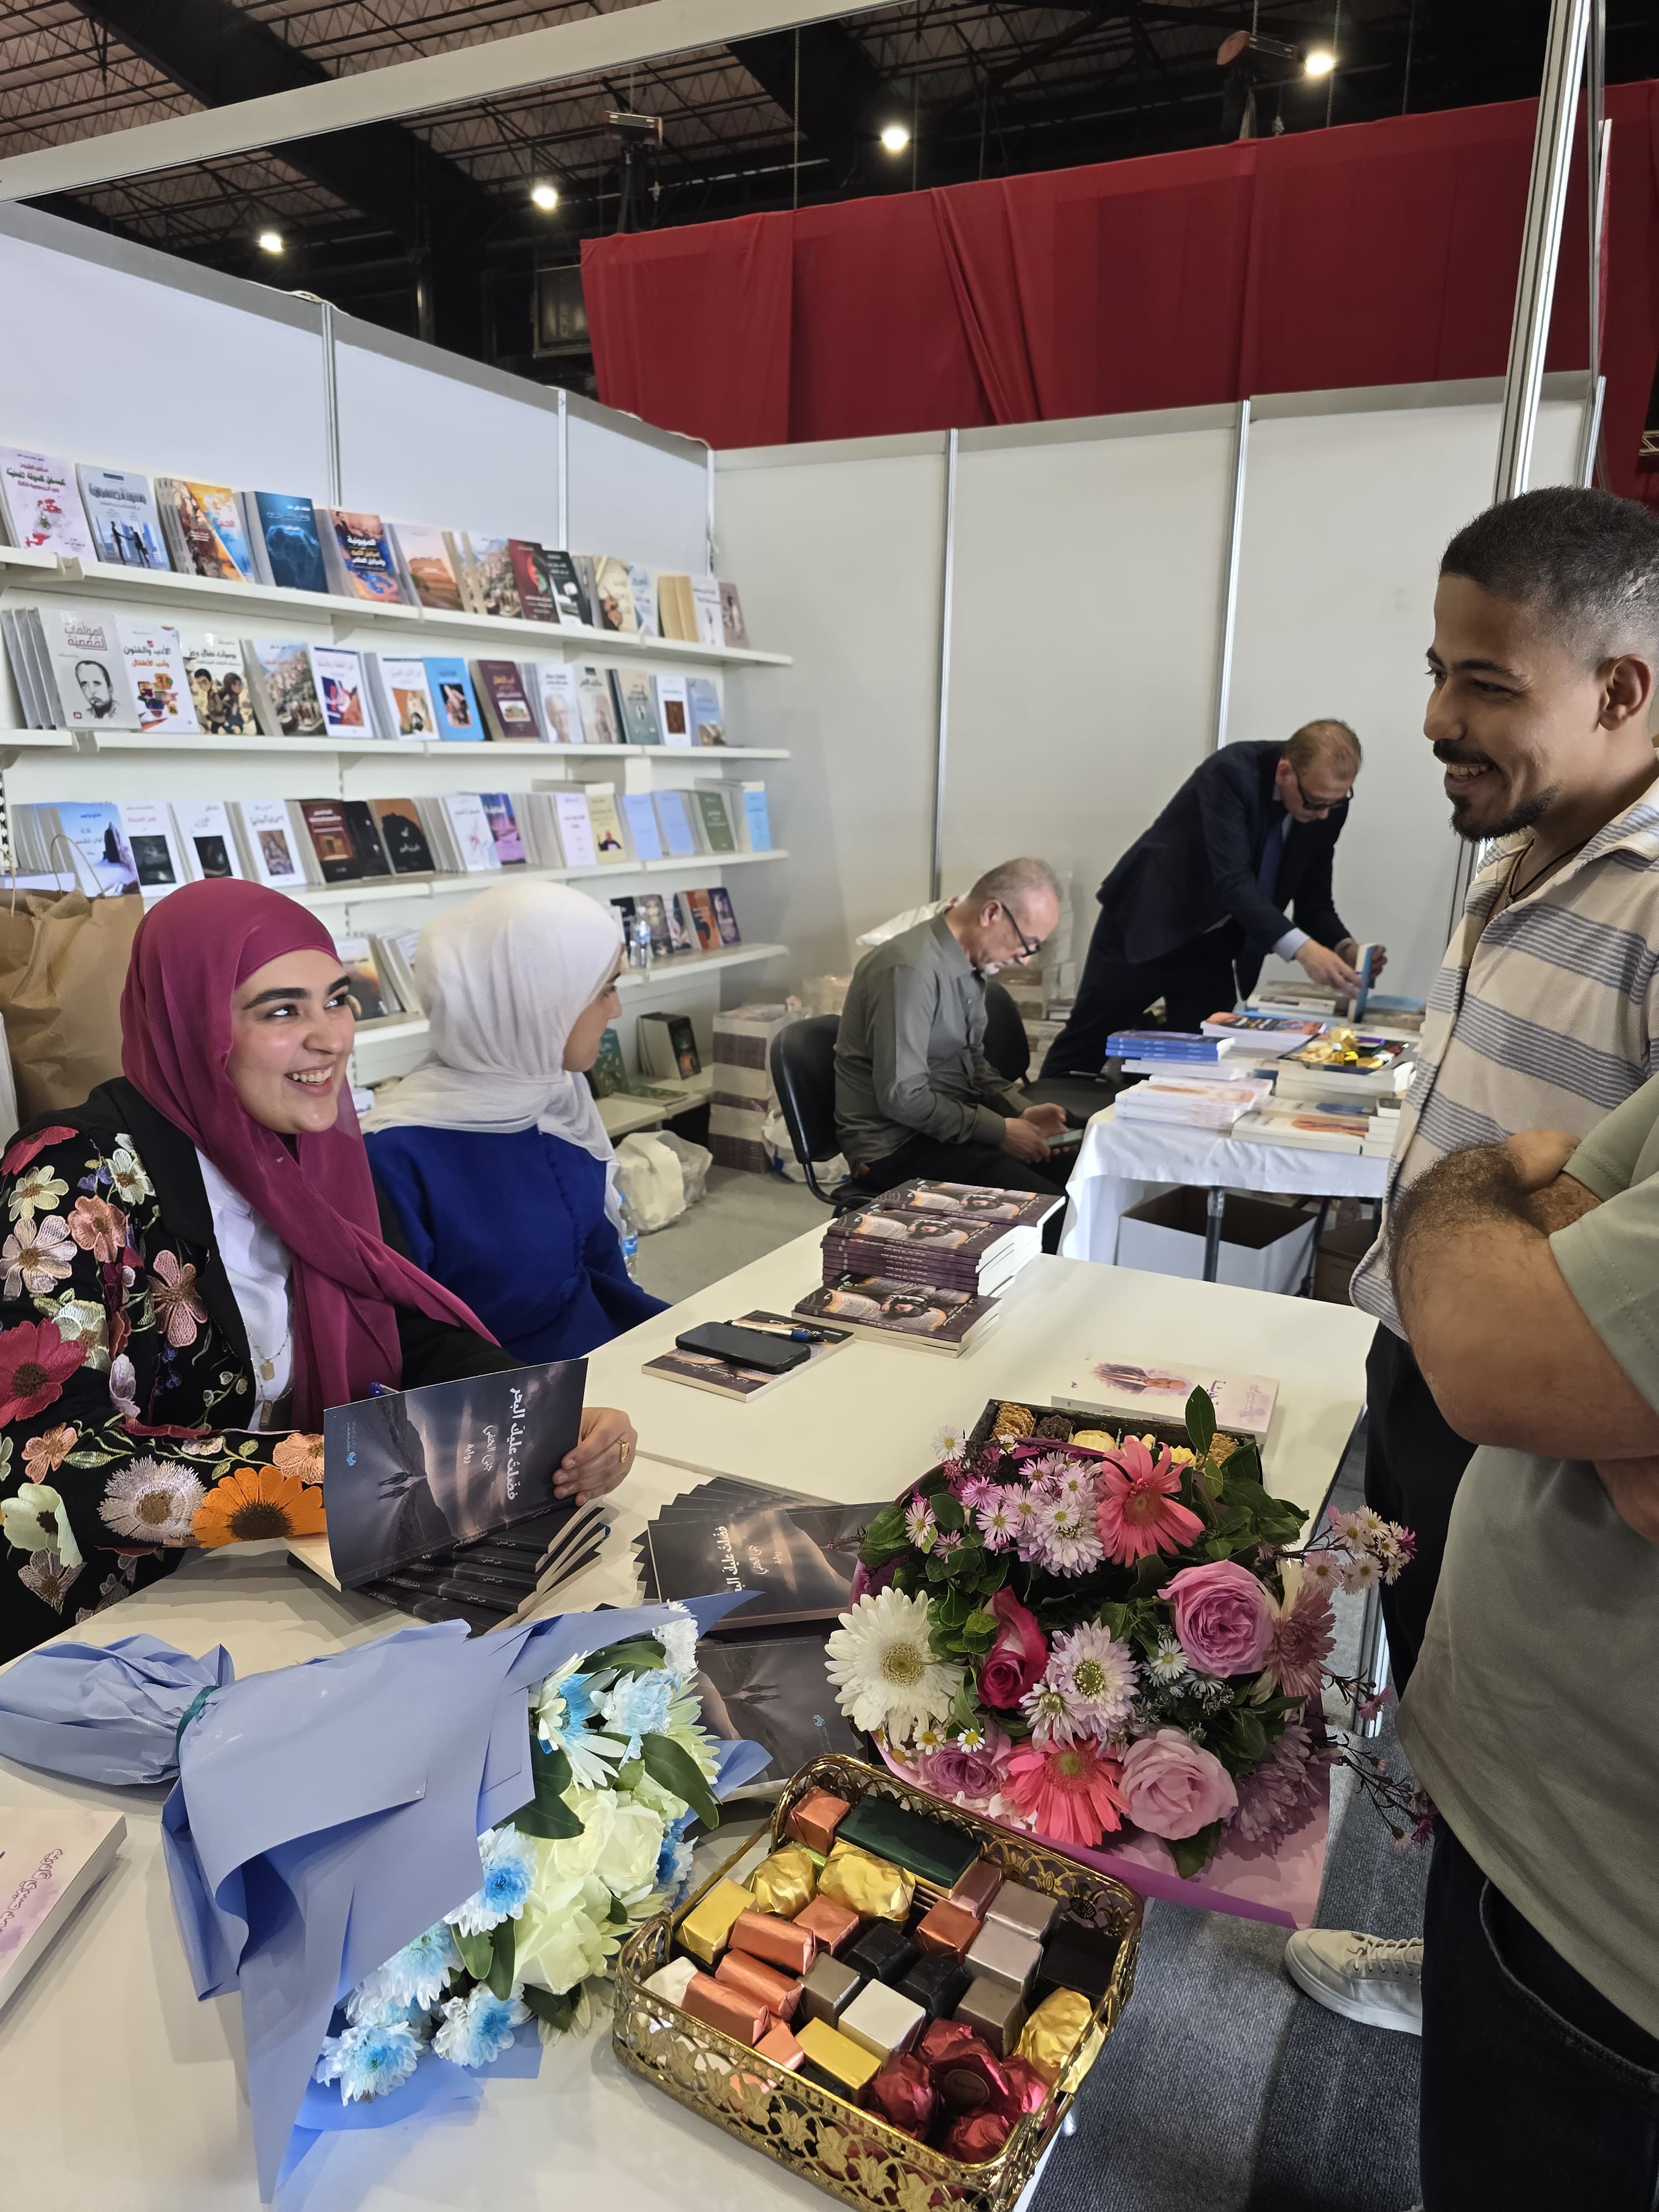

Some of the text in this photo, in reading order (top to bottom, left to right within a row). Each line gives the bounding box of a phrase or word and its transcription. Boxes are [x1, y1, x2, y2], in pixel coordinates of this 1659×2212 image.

[124, 646, 152, 656] والفنون
[509, 1387, 526, 1419] البحر
[463, 1443, 475, 1464] رواية
